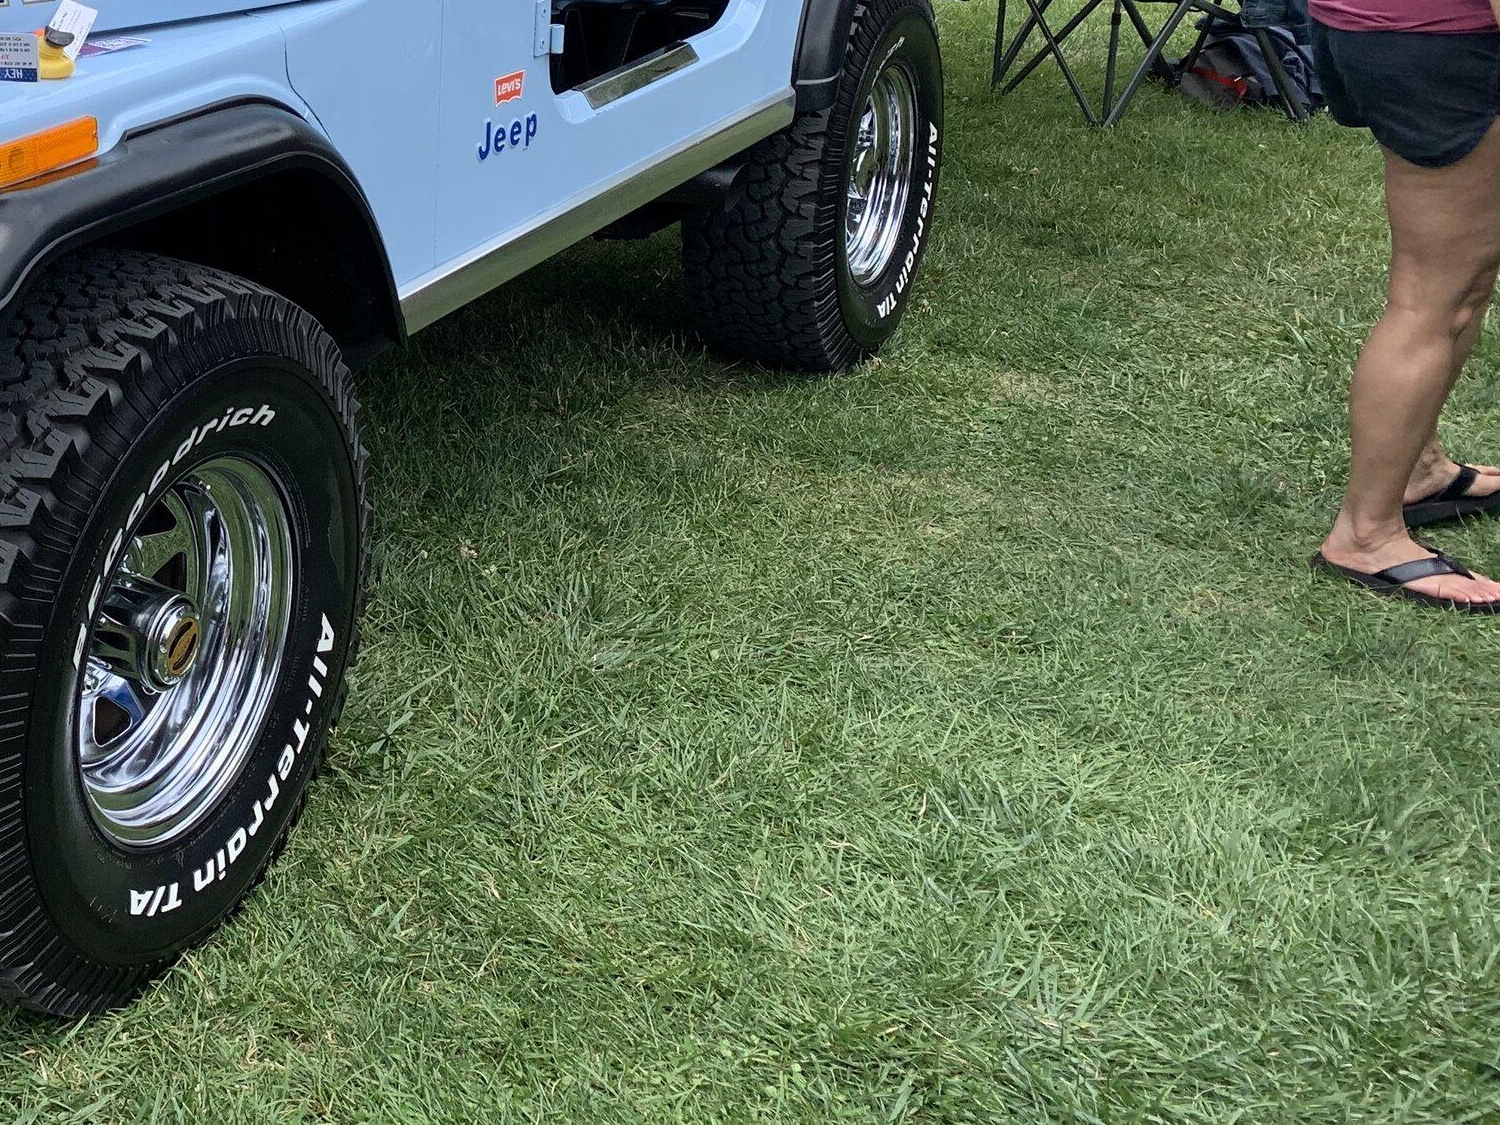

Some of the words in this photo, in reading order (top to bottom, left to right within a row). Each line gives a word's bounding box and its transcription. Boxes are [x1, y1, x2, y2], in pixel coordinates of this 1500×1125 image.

[3, 68, 23, 79] HEY
[478, 113, 538, 161] Jeep
[895, 121, 938, 294] All-Terrain
[876, 291, 898, 319] T/A
[193, 611, 335, 892] All-Terrain
[129, 881, 182, 917] T/A
